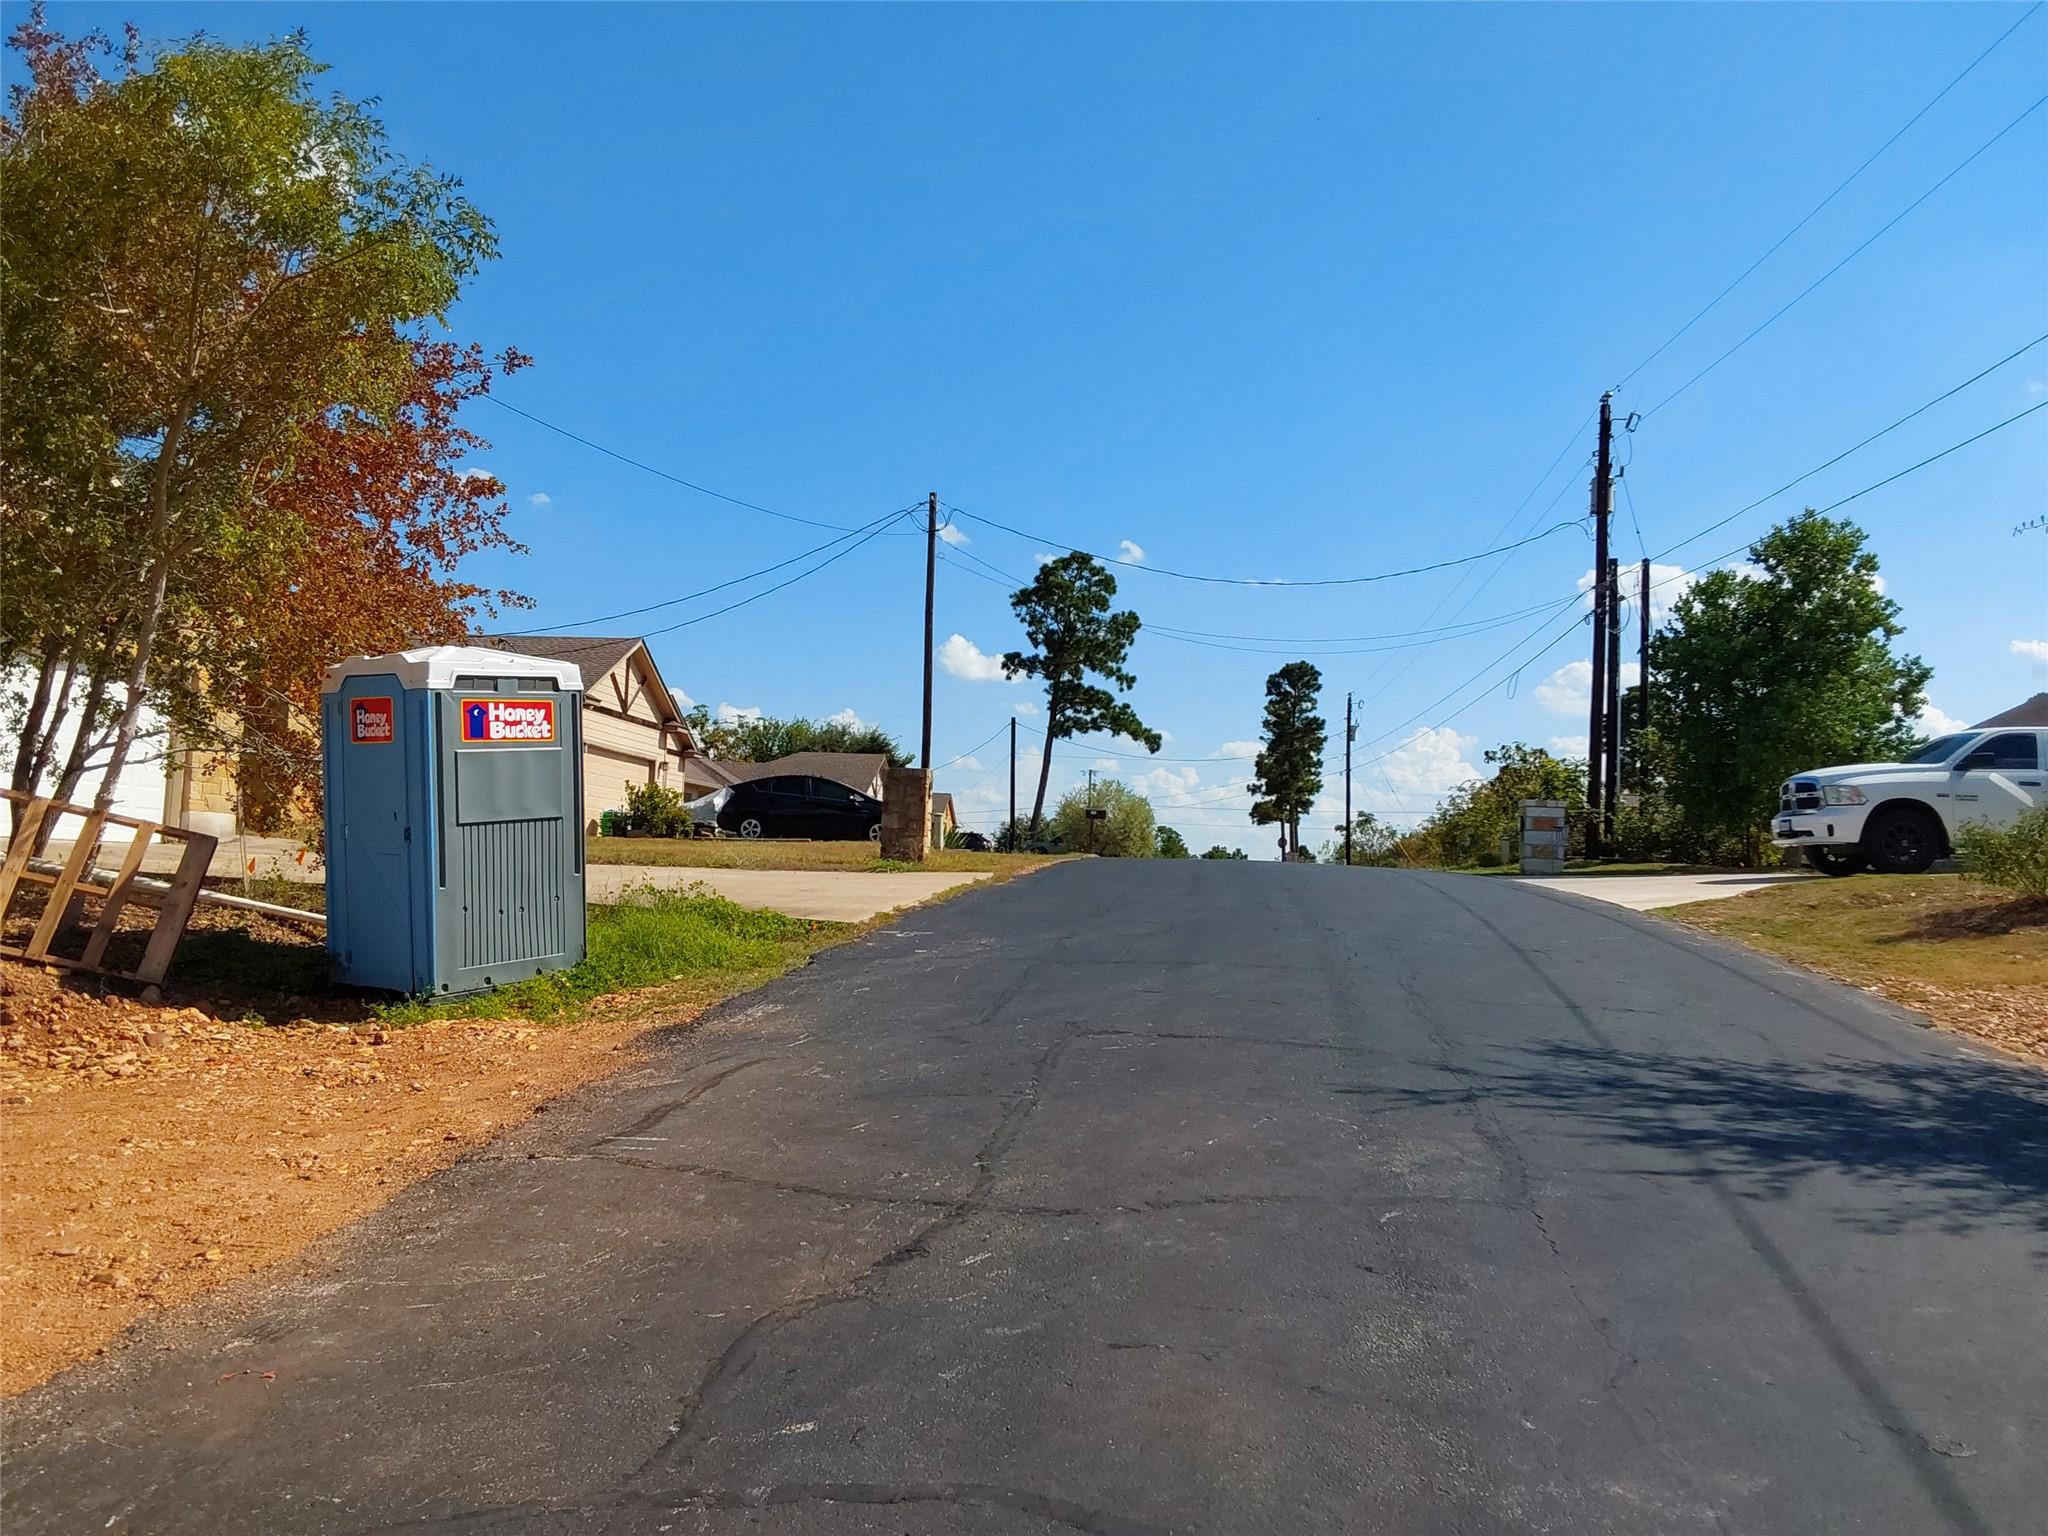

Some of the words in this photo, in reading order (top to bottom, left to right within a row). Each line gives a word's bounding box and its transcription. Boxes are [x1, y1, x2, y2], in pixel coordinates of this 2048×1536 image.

[356, 710, 387, 726] Honey
[488, 703, 545, 723] Honey
[357, 724, 390, 738] Bucket
[489, 722, 551, 739] Bucket
